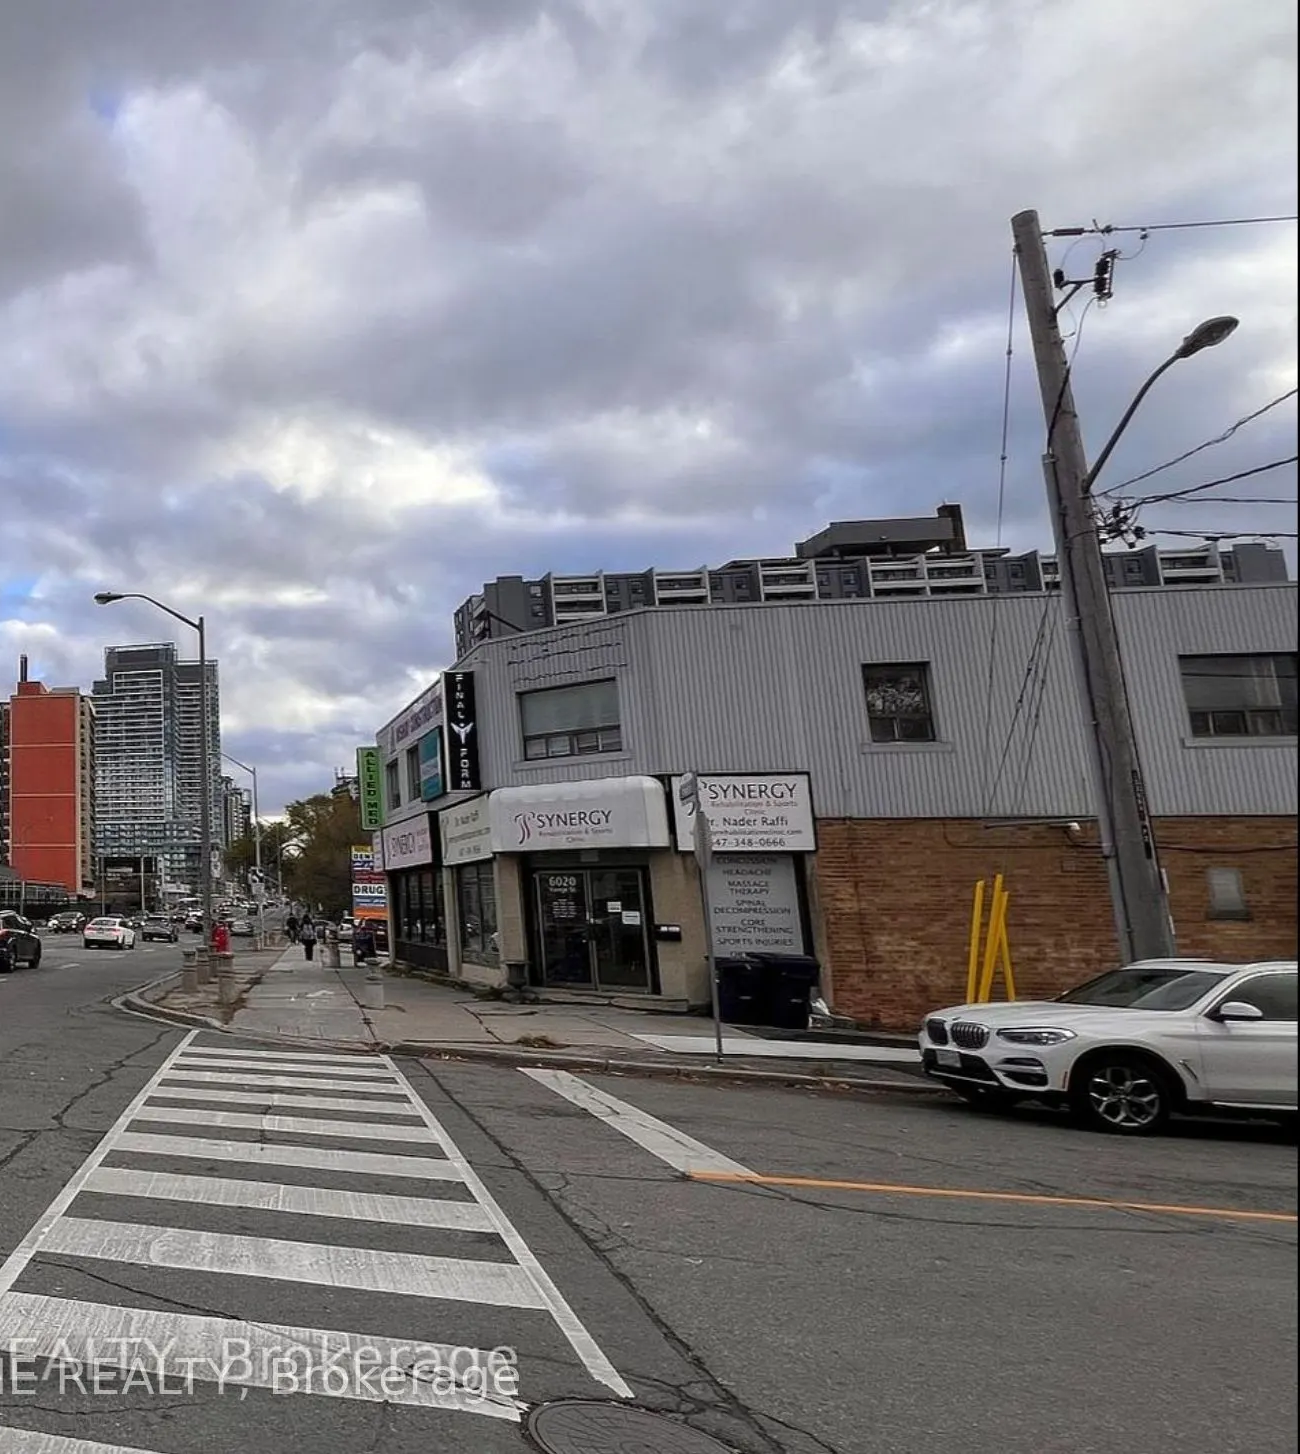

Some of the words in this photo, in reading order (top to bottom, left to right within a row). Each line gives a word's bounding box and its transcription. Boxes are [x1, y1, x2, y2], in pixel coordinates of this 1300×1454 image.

[455, 674, 465, 719] FINAL
[460, 748, 473, 788] FORM
[364, 751, 377, 797] ALLIED
[708, 783, 797, 800] SYNERGY
[367, 802, 378, 825] MED
[537, 810, 612, 828] SYNERGY
[722, 816, 757, 827] Nader
[760, 816, 788, 826] Raffi
[715, 838, 786, 847] 47-348-0666
[548, 876, 577, 887] 6020
